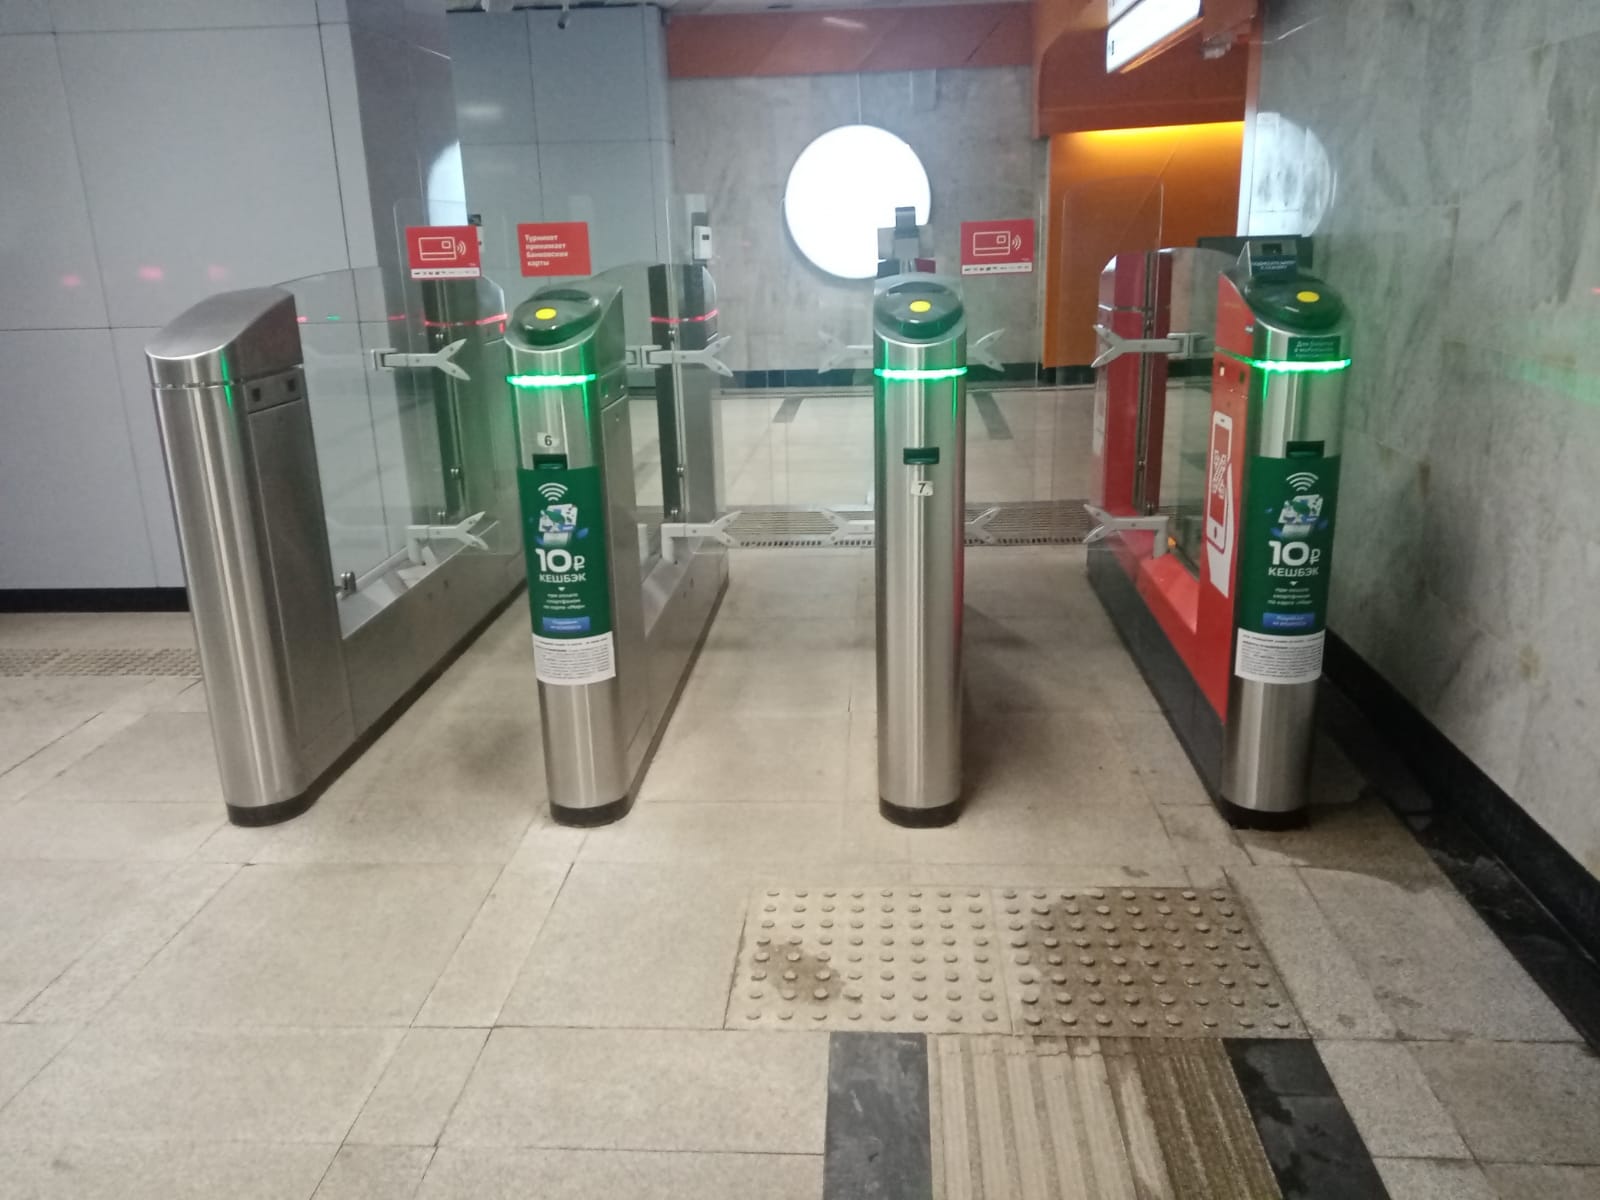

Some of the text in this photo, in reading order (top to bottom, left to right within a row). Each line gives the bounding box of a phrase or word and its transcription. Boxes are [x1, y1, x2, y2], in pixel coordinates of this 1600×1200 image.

[525, 234, 558, 243] Турникет
[526, 243, 566, 251] принимает
[527, 260, 550, 268] карты
[544, 434, 553, 447] 6
[918, 482, 927, 494] 7
[1268, 566, 1320, 577] КЕШБЭК
[539, 573, 587, 583] КЕШБЭК
